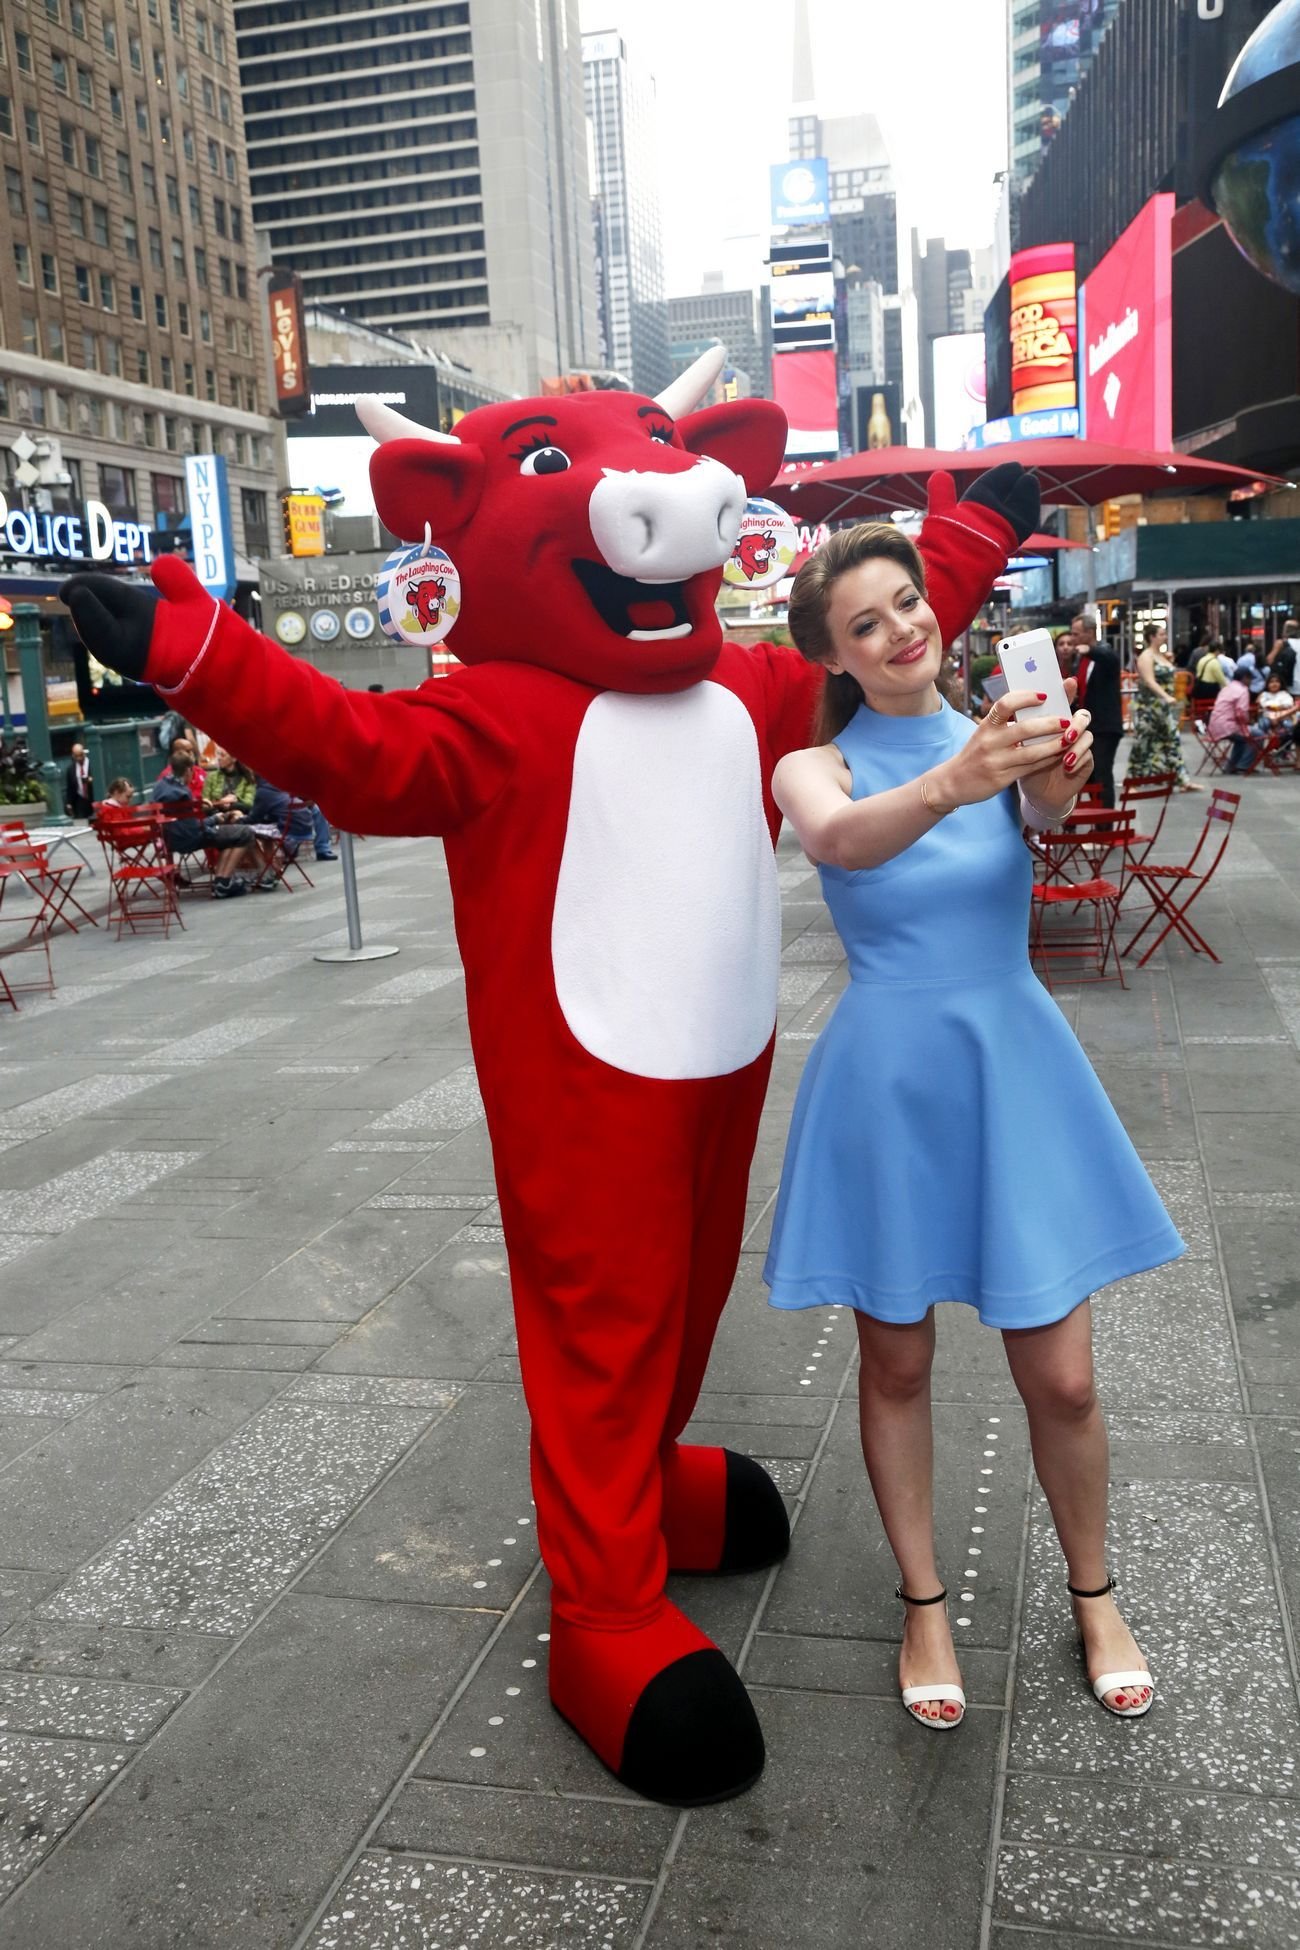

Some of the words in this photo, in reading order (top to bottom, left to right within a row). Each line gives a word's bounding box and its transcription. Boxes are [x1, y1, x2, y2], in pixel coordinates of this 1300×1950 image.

[87, 500, 151, 563] DEPT
[194, 462, 217, 580] NYPD
[396, 573, 408, 587] The
[409, 562, 439, 578] Laughing
[439, 564, 454, 575] Cow
[273, 591, 351, 607] RECRUITING
